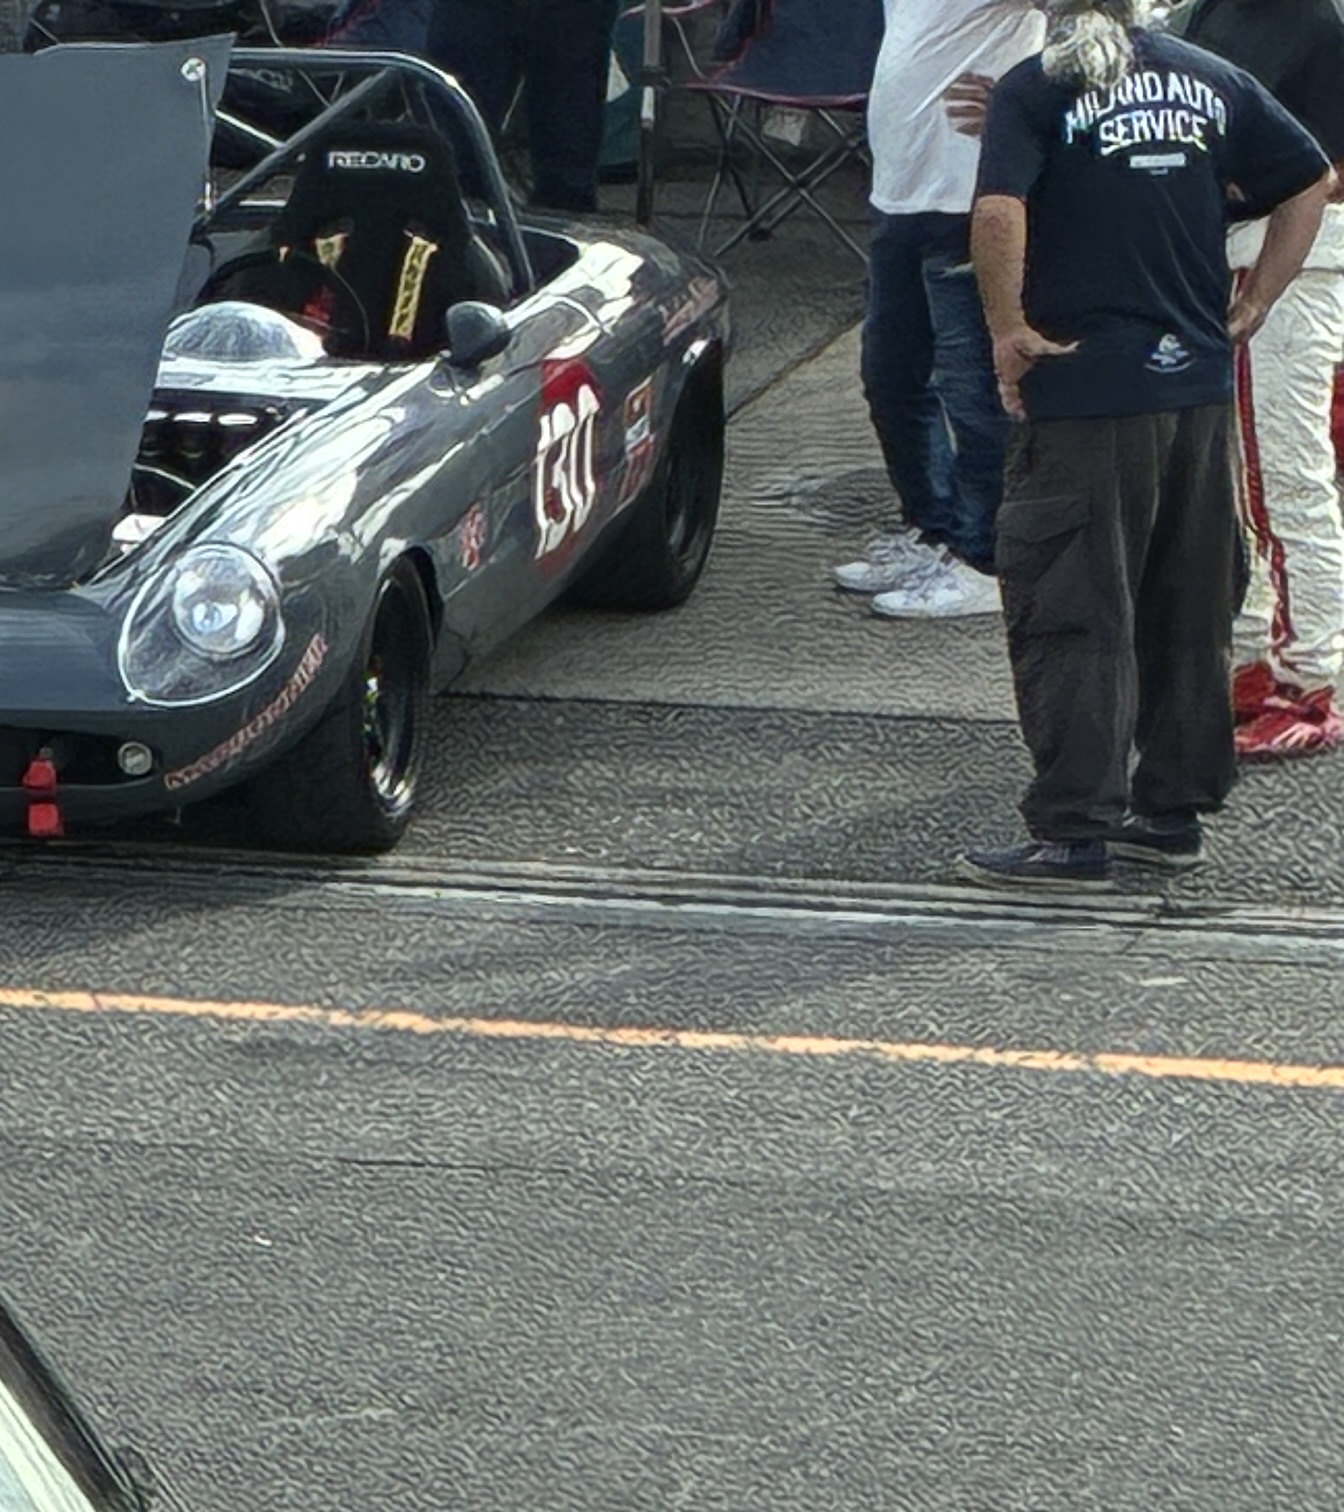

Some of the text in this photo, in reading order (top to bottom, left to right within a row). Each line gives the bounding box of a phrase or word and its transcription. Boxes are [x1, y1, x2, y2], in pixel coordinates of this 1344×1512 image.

[1167, 71, 1227, 136] AUTO
[1099, 109, 1209, 157] SERVICE
[328, 151, 426, 172] RECARO
[535, 383, 601, 560] 130
